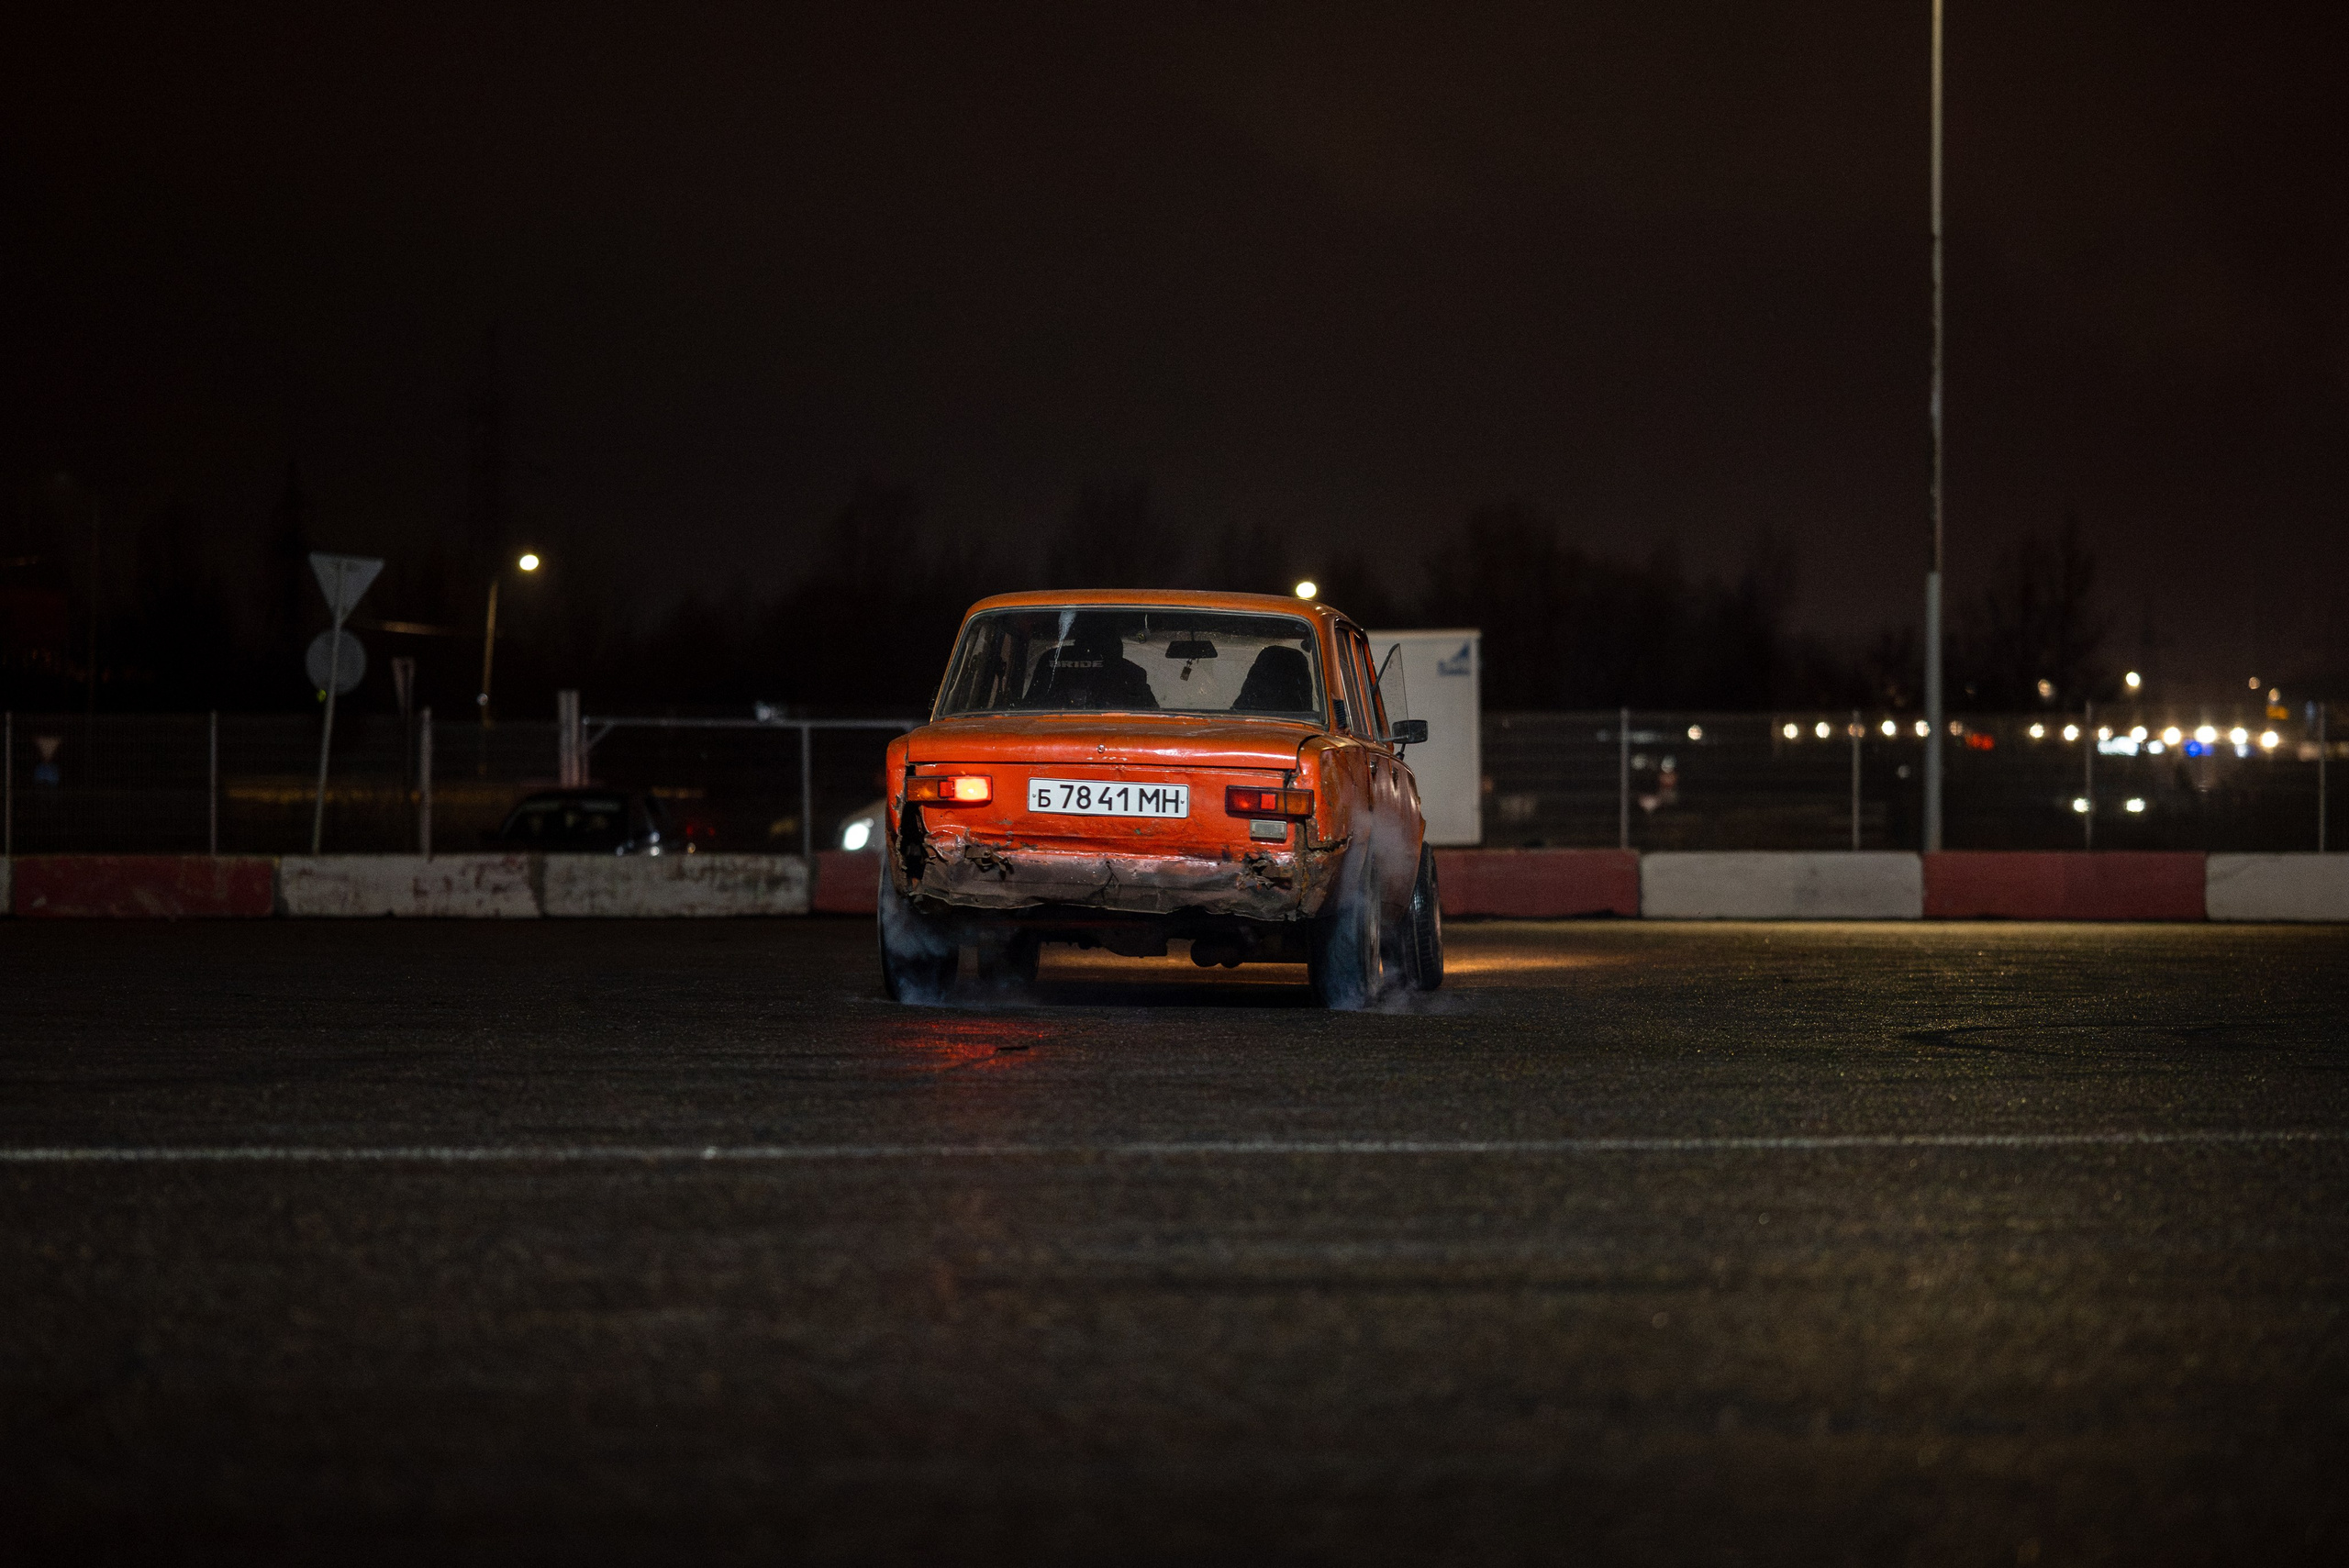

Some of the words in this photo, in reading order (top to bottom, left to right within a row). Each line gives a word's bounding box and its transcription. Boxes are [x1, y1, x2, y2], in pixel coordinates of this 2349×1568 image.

[1038, 789, 1051, 807] Б
[1060, 784, 1091, 809] 78
[1097, 786, 1129, 811] 41
[1139, 788, 1179, 813] МН
